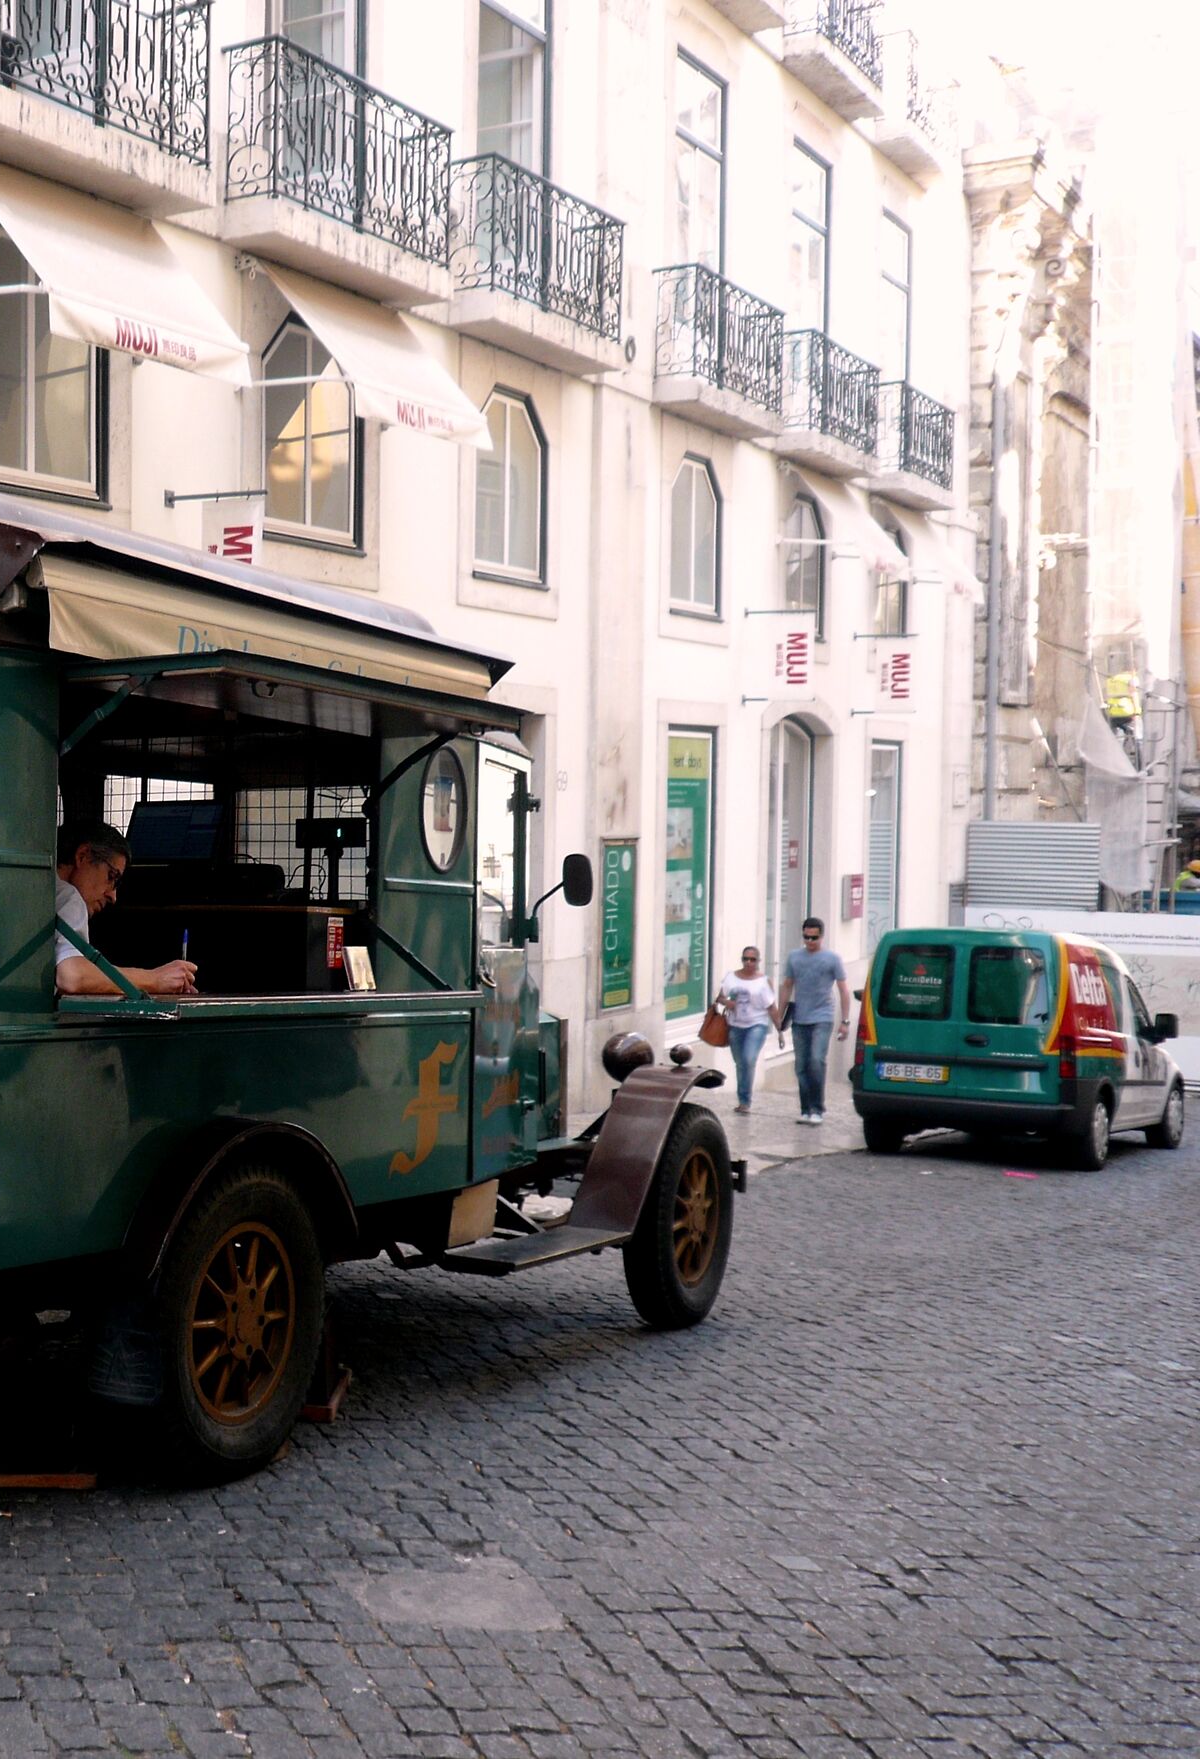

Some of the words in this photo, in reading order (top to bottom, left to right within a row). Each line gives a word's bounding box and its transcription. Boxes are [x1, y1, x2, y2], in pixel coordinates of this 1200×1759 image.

[115, 317, 158, 357] MUJI
[397, 400, 425, 430] MUJI
[786, 633, 808, 684] MUJI
[891, 653, 911, 699] MUJI
[605, 850, 619, 951] CHIADO
[1069, 962, 1108, 1006] Delta
